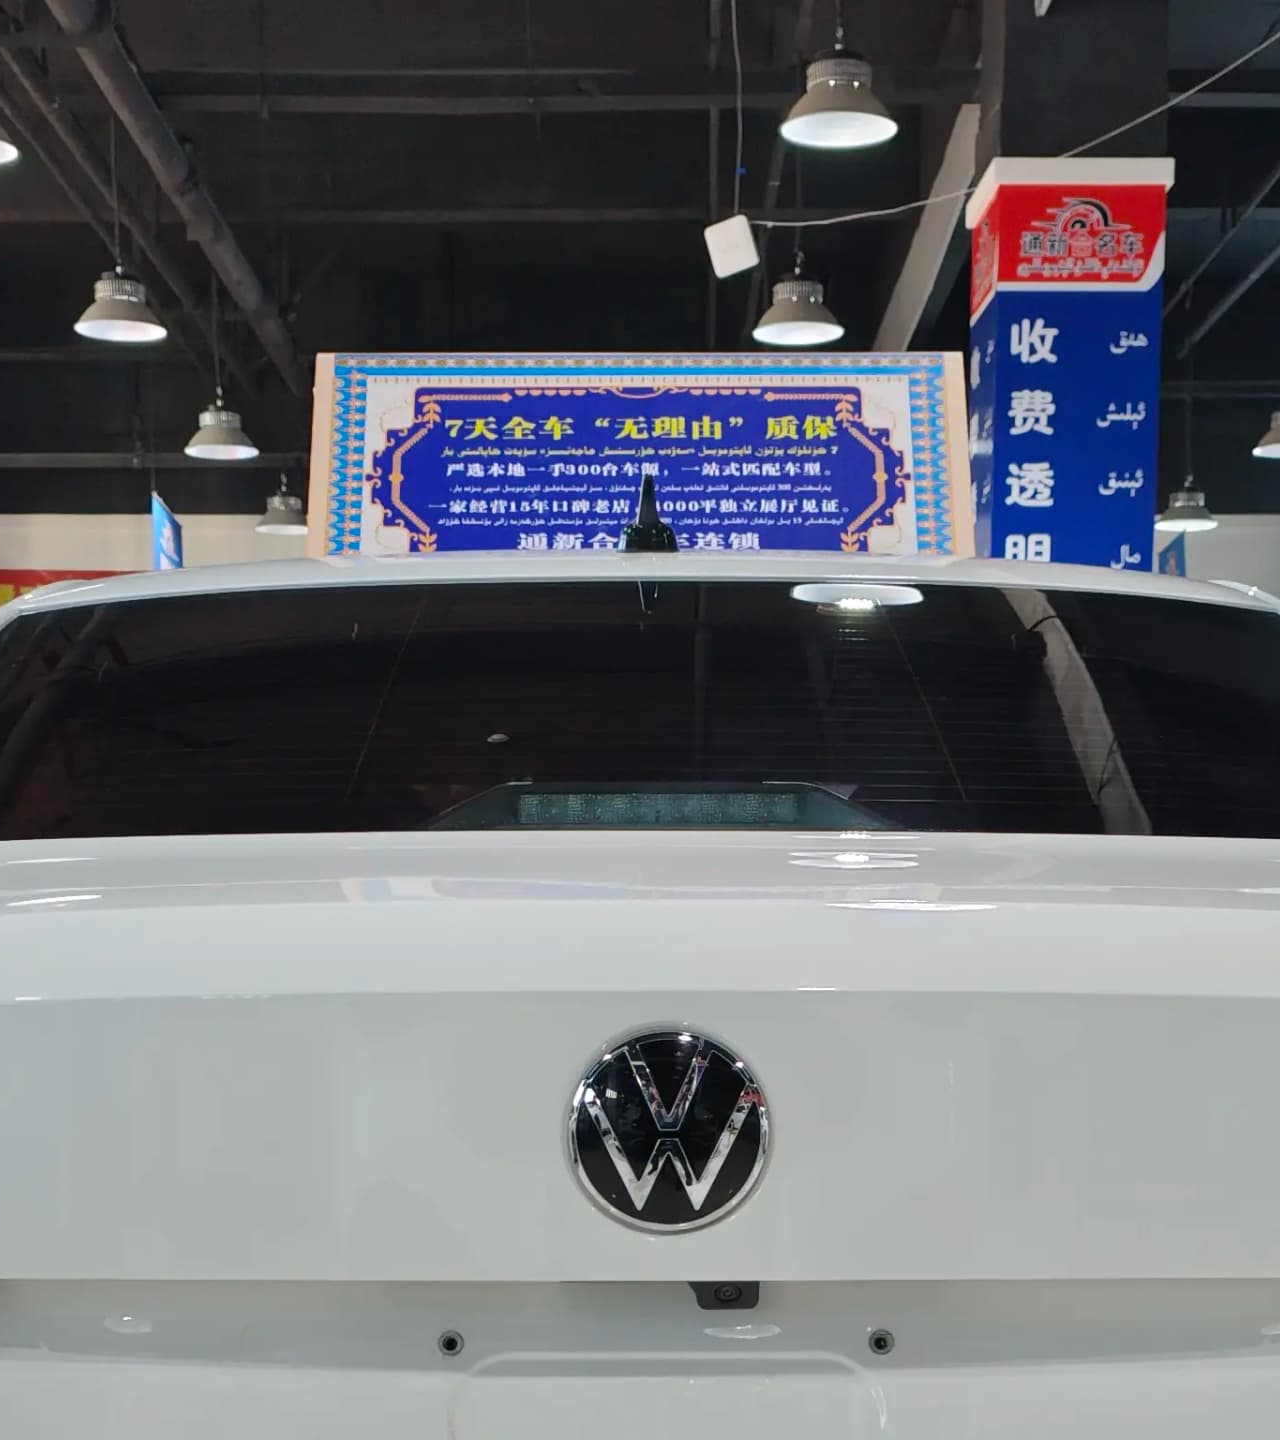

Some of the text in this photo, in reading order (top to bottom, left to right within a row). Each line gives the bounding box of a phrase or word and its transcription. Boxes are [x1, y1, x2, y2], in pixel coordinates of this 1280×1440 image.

[517, 532, 760, 550] 通新合连锁
